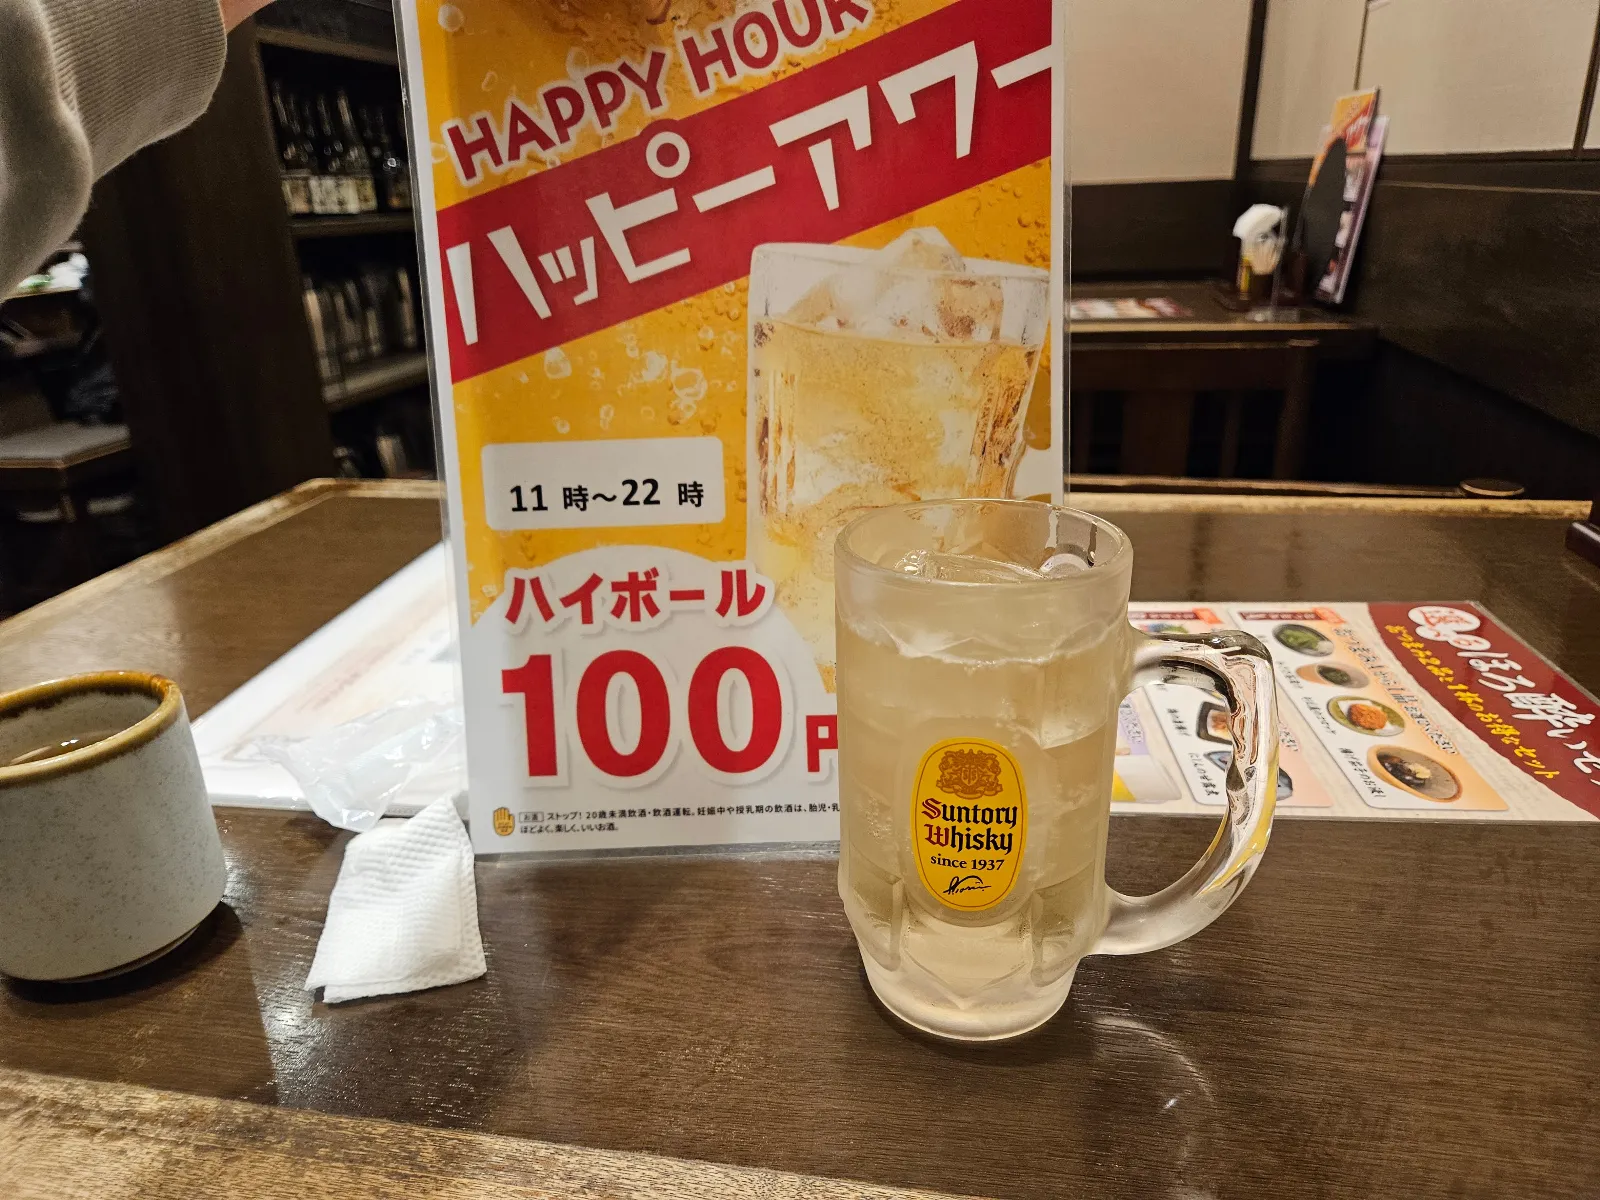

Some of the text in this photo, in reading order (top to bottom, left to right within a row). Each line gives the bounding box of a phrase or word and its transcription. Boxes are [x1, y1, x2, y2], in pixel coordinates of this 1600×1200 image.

[448, 52, 667, 181] HAPPY
[446, 41, 1052, 346] ハッピーアワー
[504, 566, 767, 624] ハイボール
[920, 797, 1018, 829] Suntory
[923, 823, 1013, 855] Whisky
[930, 853, 1005, 871] since 1937
